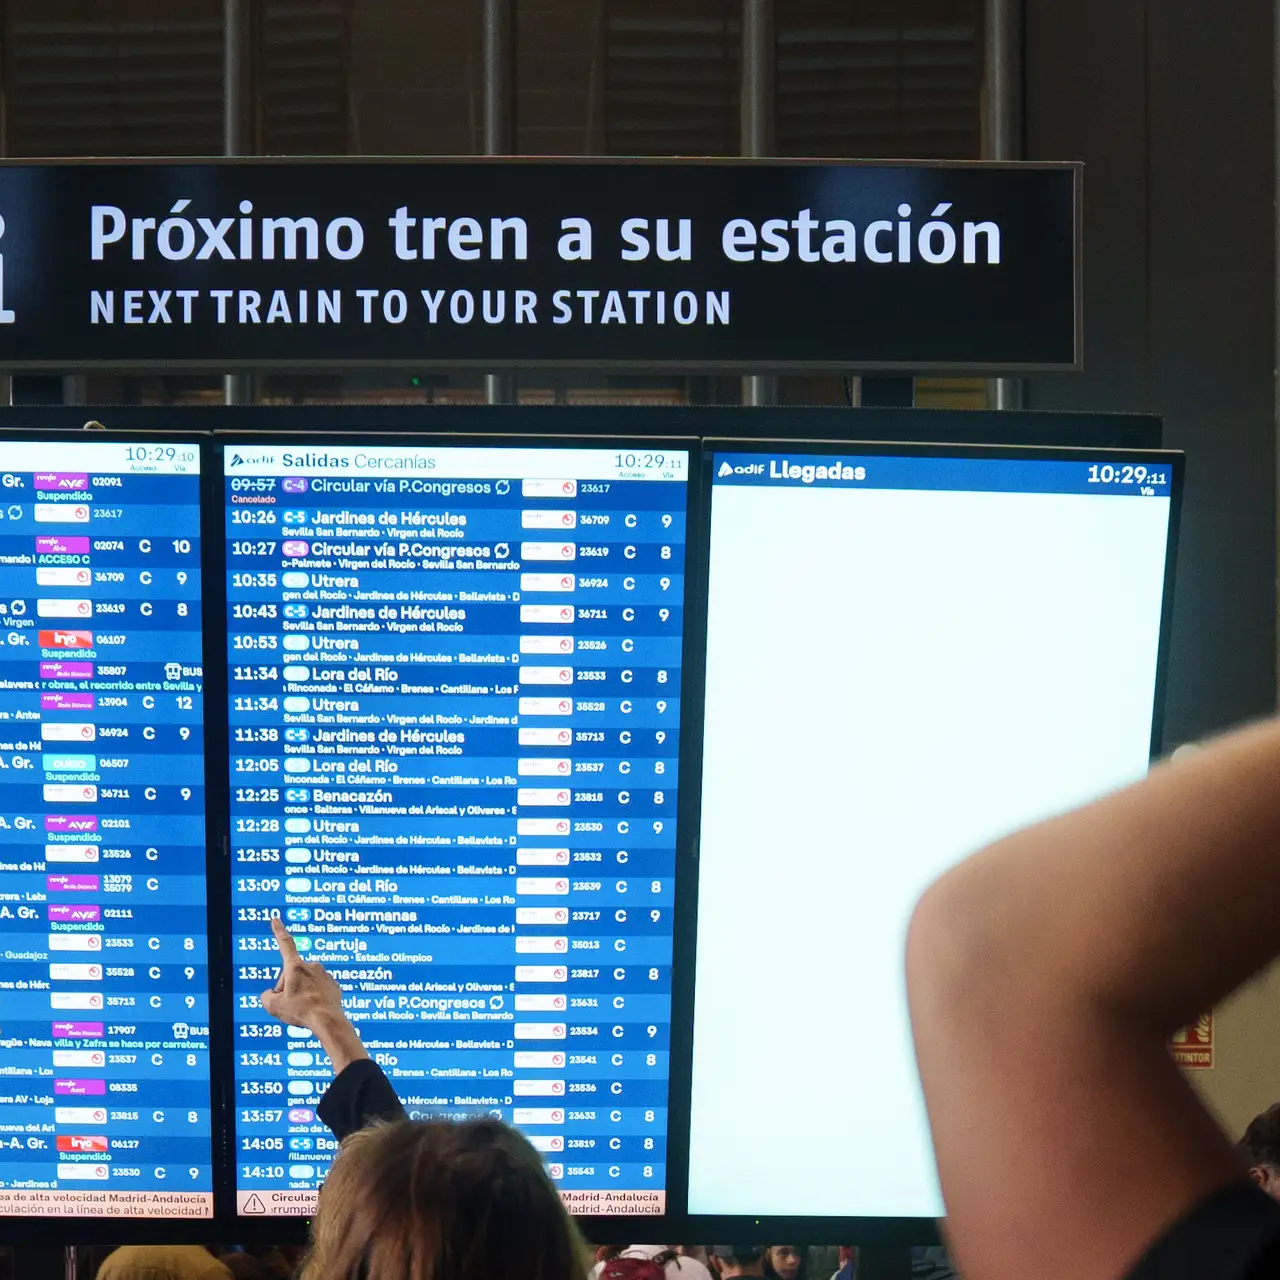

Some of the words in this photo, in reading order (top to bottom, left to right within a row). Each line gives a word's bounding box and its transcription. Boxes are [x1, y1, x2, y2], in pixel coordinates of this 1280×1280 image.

[92, 200, 364, 260] Próximo
[389, 206, 527, 260] tren
[558, 218, 591, 260] a
[621, 218, 691, 261] su
[722, 203, 1000, 264] estación
[91, 290, 199, 323] NEXT
[210, 290, 340, 323] TRAIN
[356, 290, 407, 323] TO
[421, 290, 537, 323] YOUR
[553, 290, 729, 324] STATION
[282, 453, 348, 467] Salidas
[354, 454, 435, 468] Cercanías
[770, 461, 865, 483] Llegadas
[2, 474, 24, 487] Gr.
[92, 477, 122, 487] 02091
[311, 478, 370, 492] Circular
[373, 479, 395, 492] vía
[399, 479, 491, 496] P.Congresos
[93, 509, 122, 519] 23617
[232, 510, 276, 523] 10:26
[311, 510, 375, 524] Jardines
[378, 511, 397, 525] de
[401, 511, 466, 525] Hércules
[580, 515, 609, 525] 36709
[625, 514, 636, 527] C
[661, 514, 672, 528] 9
[93, 540, 124, 550] 02074
[139, 539, 151, 552] C
[172, 539, 190, 553] 10
[95, 572, 124, 582] 36709
[139, 571, 151, 584] C
[176, 571, 187, 584] 9
[96, 603, 125, 613] 23619
[140, 603, 152, 615] C
[177, 603, 187, 616] 8
[7, 632, 29, 645] Gr.
[96, 635, 126, 645] 06107
[97, 666, 126, 676] 35807
[182, 667, 203, 677] BUS
[98, 697, 127, 707] 13904
[142, 696, 154, 708] C
[175, 696, 192, 709] 12
[236, 819, 279, 831] 12:28
[313, 819, 359, 832] Utrera
[238, 908, 281, 921] 13:10
[314, 908, 342, 921] Dos
[345, 908, 417, 921] Hermanas
[572, 911, 600, 921] 23717
[615, 909, 626, 922] C
[650, 909, 660, 922] 9
[105, 938, 133, 948] 23533
[148, 937, 159, 949] C
[183, 937, 194, 950] 8
[314, 937, 367, 952] Cartuja
[572, 940, 600, 950] 35013
[108, 1025, 136, 1035] 17907
[189, 1026, 209, 1036] BUS
[1175, 1052, 1210, 1063] TINTOR
[109, 1082, 137, 1092] 08335
[110, 1111, 138, 1121] 23815
[152, 1111, 164, 1122] C
[187, 1111, 198, 1122] 8
[242, 1138, 283, 1149] 14:05
[567, 1138, 595, 1148] 23819
[609, 1137, 620, 1149] C
[643, 1138, 653, 1149] 8
[13, 1191, 26, 1201] de
[29, 1192, 50, 1202] alta
[53, 1193, 105, 1203] velocidad
[109, 1193, 206, 1203] Madrid-Andalucía
[560, 1193, 658, 1203] Madrid-Andalucía
